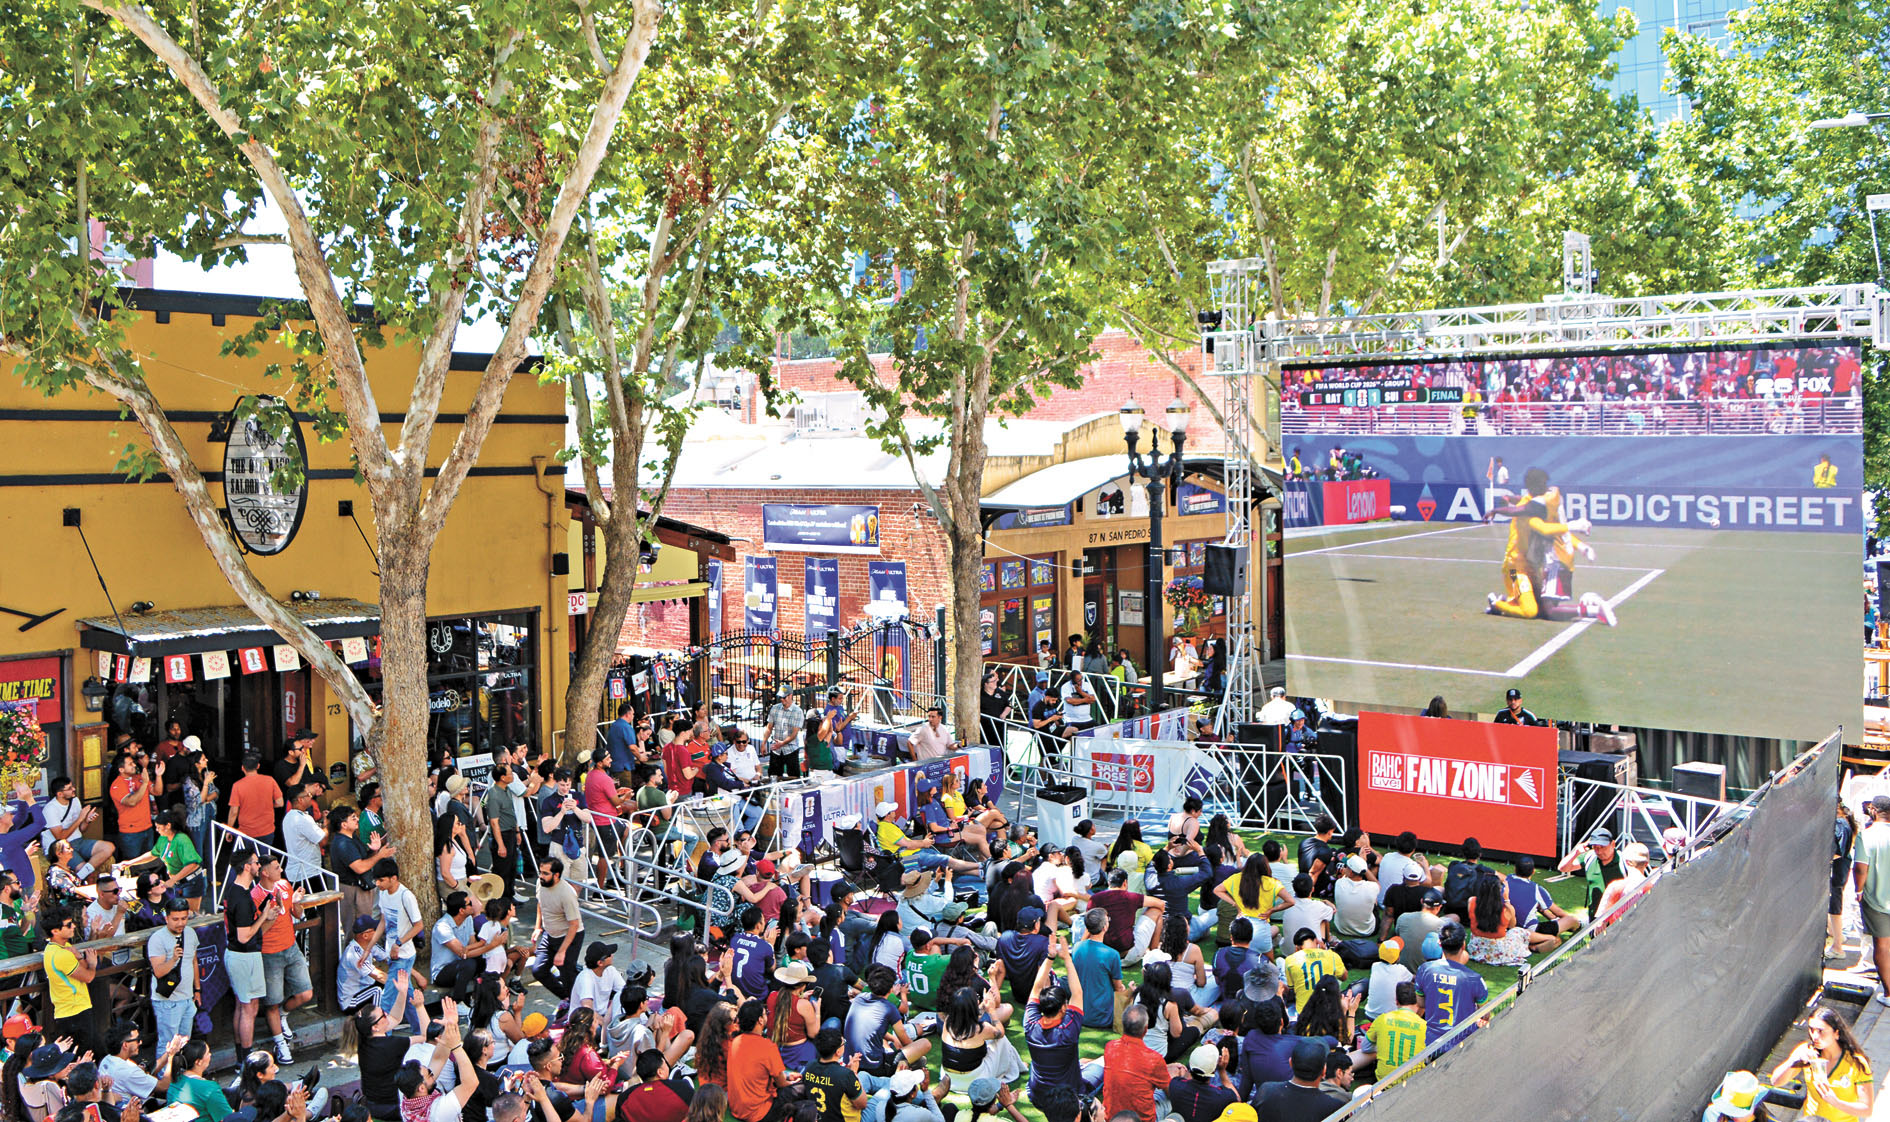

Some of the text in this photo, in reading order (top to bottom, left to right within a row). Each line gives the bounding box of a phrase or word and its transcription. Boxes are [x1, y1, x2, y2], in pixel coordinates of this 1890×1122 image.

[1798, 377, 1832, 392] FOX
[1325, 390, 1460, 404] QAT 1 1 SUI FINAL
[231, 458, 246, 473] THE
[231, 478, 259, 494] SALOON
[1347, 485, 1377, 521] Lenovo
[1564, 492, 1853, 527] REDICTSTREET
[1089, 533, 1098, 543] 87
[1109, 531, 1123, 541] SAN
[1124, 529, 1147, 539] PEDRO
[568, 594, 585, 607] DC
[23, 678, 52, 698] TIME
[327, 703, 341, 716] 73
[470, 767, 487, 777] LINE
[1096, 763, 1120, 772] SAN
[1372, 753, 1402, 778] BAHC
[1373, 778, 1401, 788] Live!
[1406, 756, 1507, 802] FAN ZONE
[823, 809, 847, 822] ULTRA
[200, 955, 220, 964] TRA
[737, 947, 750, 978] 7
[908, 960, 923, 973] PELE
[906, 969, 929, 994] 10
[1300, 960, 1324, 990] 10
[1438, 987, 1454, 1026] 3
[1385, 1030, 1417, 1067] 10
[805, 1071, 834, 1087] BRAZIL
[810, 1086, 827, 1113] 3
